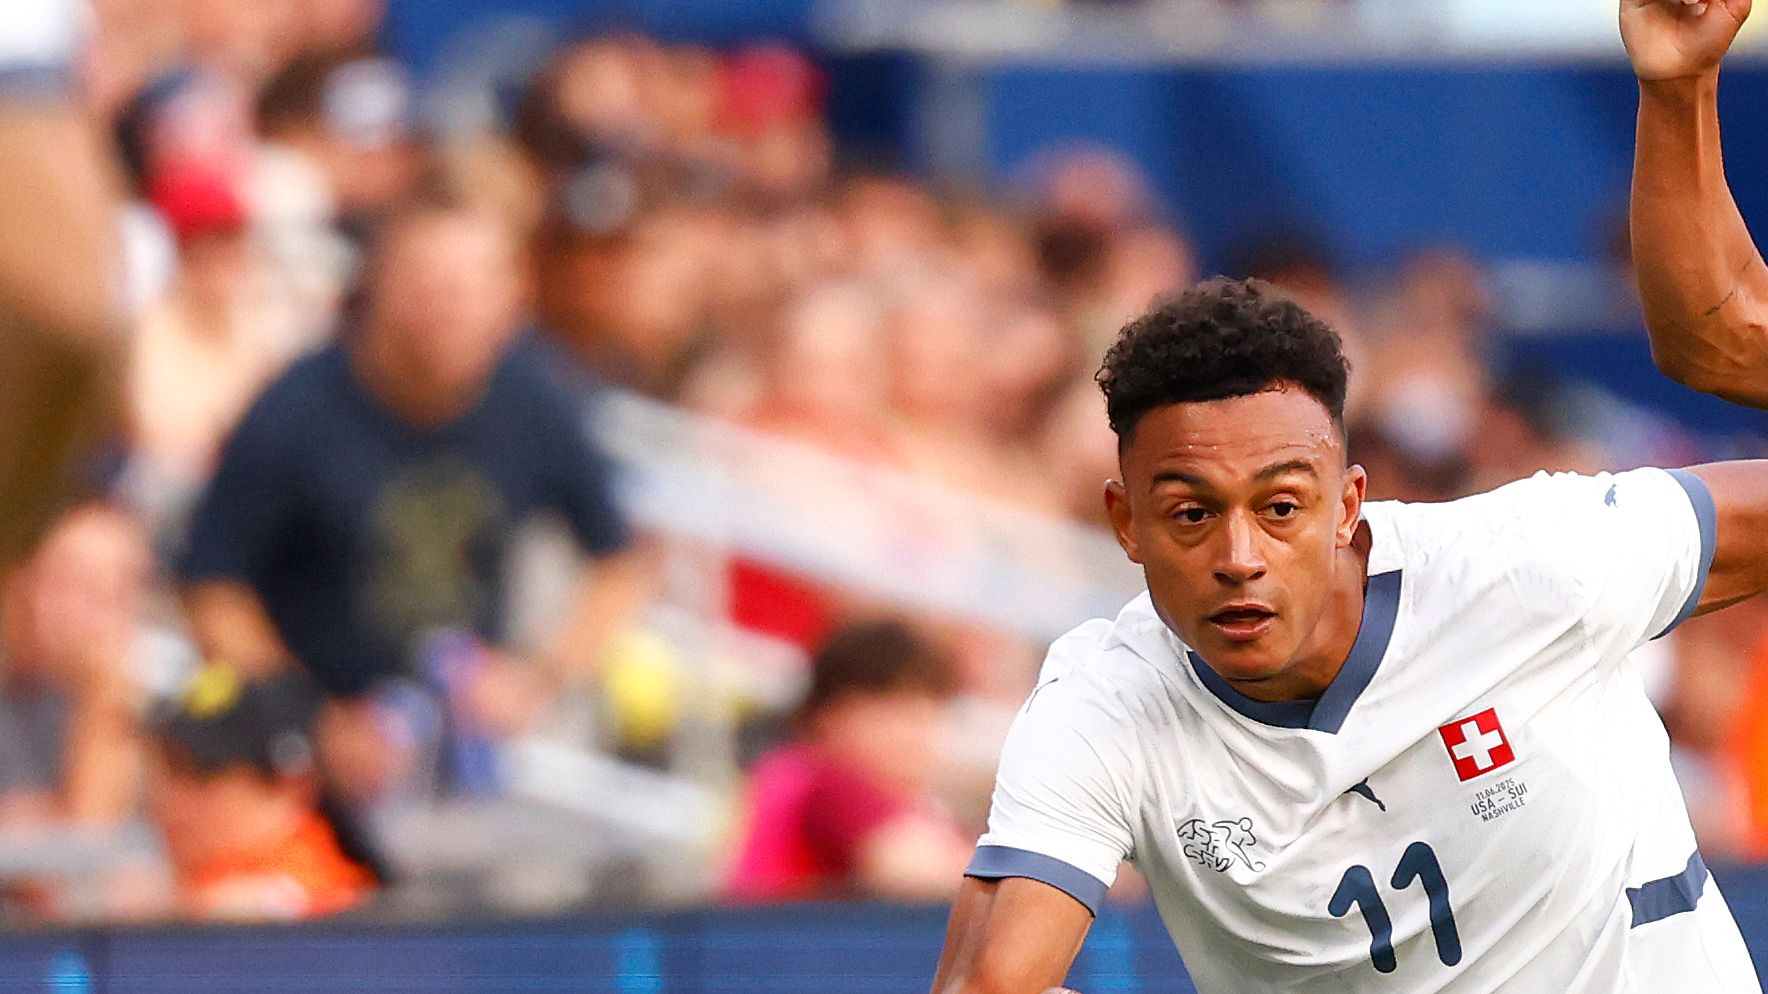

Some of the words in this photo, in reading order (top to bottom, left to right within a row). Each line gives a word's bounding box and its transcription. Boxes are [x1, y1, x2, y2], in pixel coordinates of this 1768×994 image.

[1470, 799, 1496, 816] USA
[1508, 782, 1528, 801] SUI
[1481, 799, 1525, 823] NASHVILLE
[1327, 841, 1463, 974] 11
